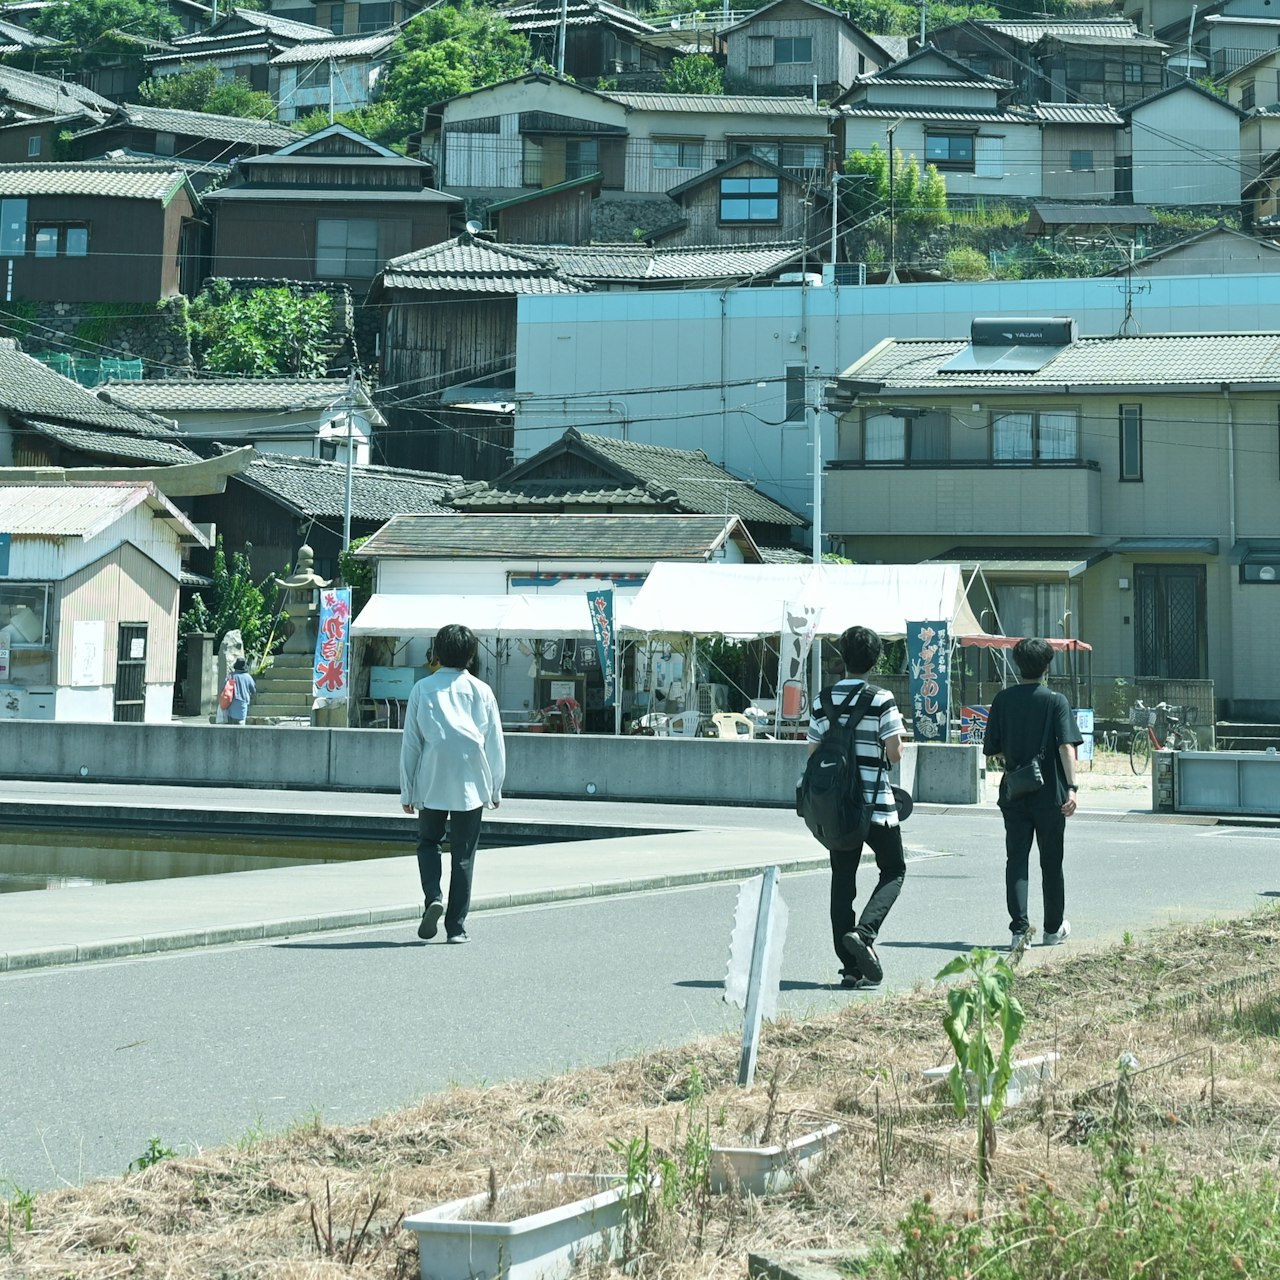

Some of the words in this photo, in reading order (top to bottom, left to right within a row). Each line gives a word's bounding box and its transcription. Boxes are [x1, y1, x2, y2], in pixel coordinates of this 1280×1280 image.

[315, 616, 346, 691] かき氷
[918, 627, 939, 715] サザエめし
